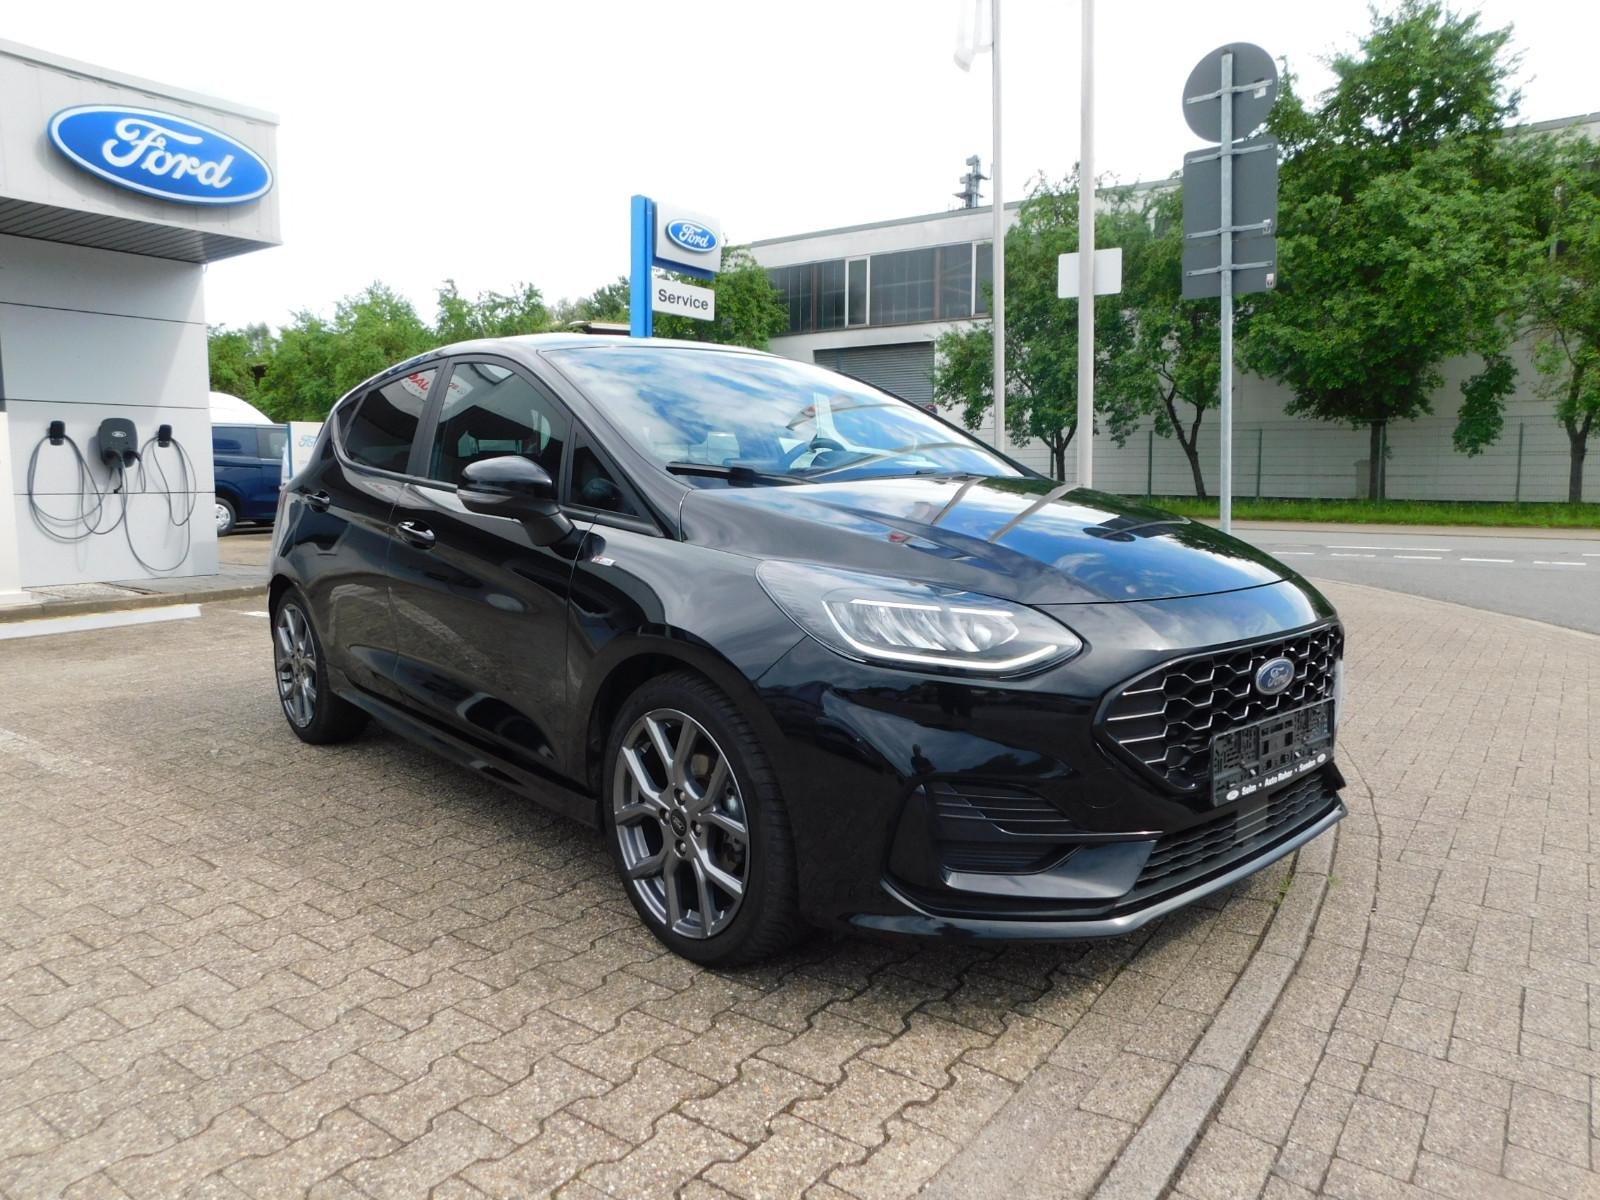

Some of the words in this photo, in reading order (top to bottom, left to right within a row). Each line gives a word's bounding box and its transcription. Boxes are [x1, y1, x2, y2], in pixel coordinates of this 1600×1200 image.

[102, 118, 235, 189] Ford
[679, 224, 709, 248] Ford
[658, 288, 709, 311] Service
